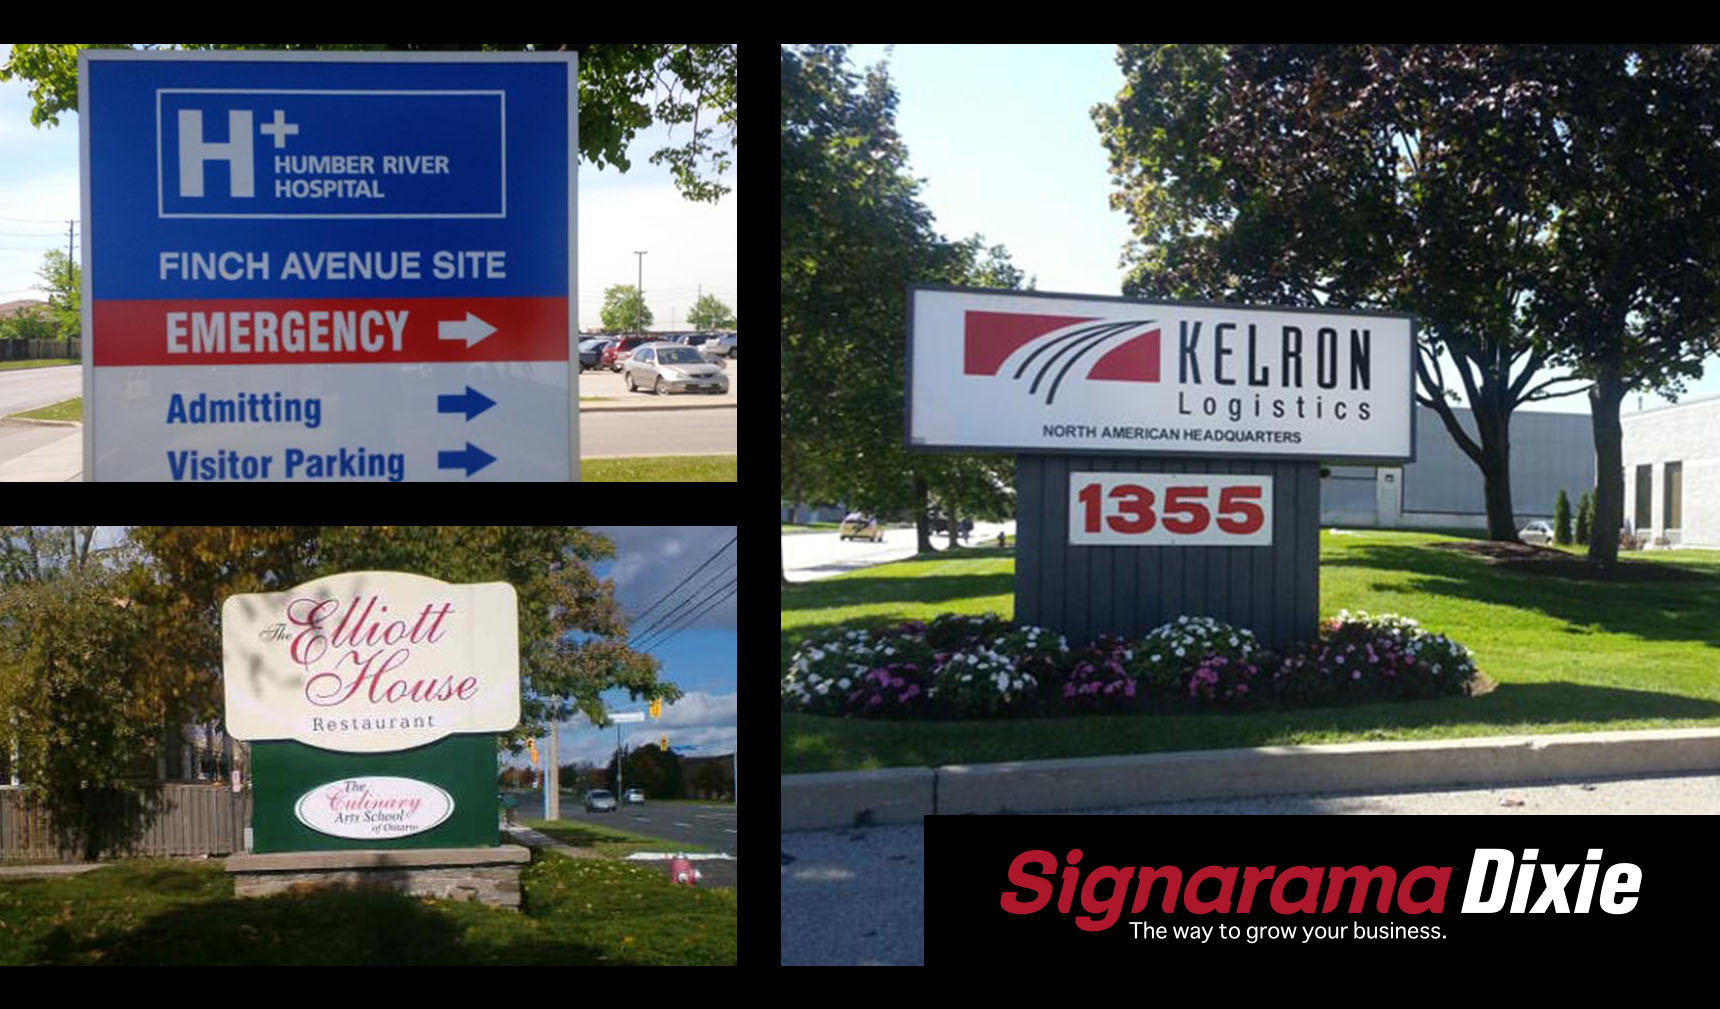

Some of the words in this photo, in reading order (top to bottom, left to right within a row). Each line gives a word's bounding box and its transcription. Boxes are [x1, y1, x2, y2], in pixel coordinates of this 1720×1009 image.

[274, 154, 375, 175] HUMBER
[382, 155, 450, 175] RIVER
[274, 178, 385, 199] HOSPITAL
[160, 252, 270, 281] FINCH
[281, 251, 421, 280] AVENUE
[432, 250, 506, 279] SITE
[166, 310, 410, 355] EMERGENCY
[1179, 319, 1371, 391] KELRON
[166, 391, 322, 428] Admitting
[1179, 391, 1371, 421] Logistics
[1042, 424, 1097, 440] NORTH
[1101, 426, 1181, 442] AMERICAN
[1183, 428, 1302, 445] HEADQUARTERS
[167, 448, 273, 481] Visitor
[285, 446, 406, 482] Parking
[1078, 482, 1266, 537] 1355
[259, 622, 293, 643] The
[287, 595, 456, 671] Elliott
[304, 648, 478, 707] House
[312, 714, 437, 733] Restaurant
[327, 788, 421, 813] Culinary
[344, 781, 366, 792] The
[334, 811, 360, 824] Arts
[363, 809, 405, 822] School
[371, 823, 382, 833] of
